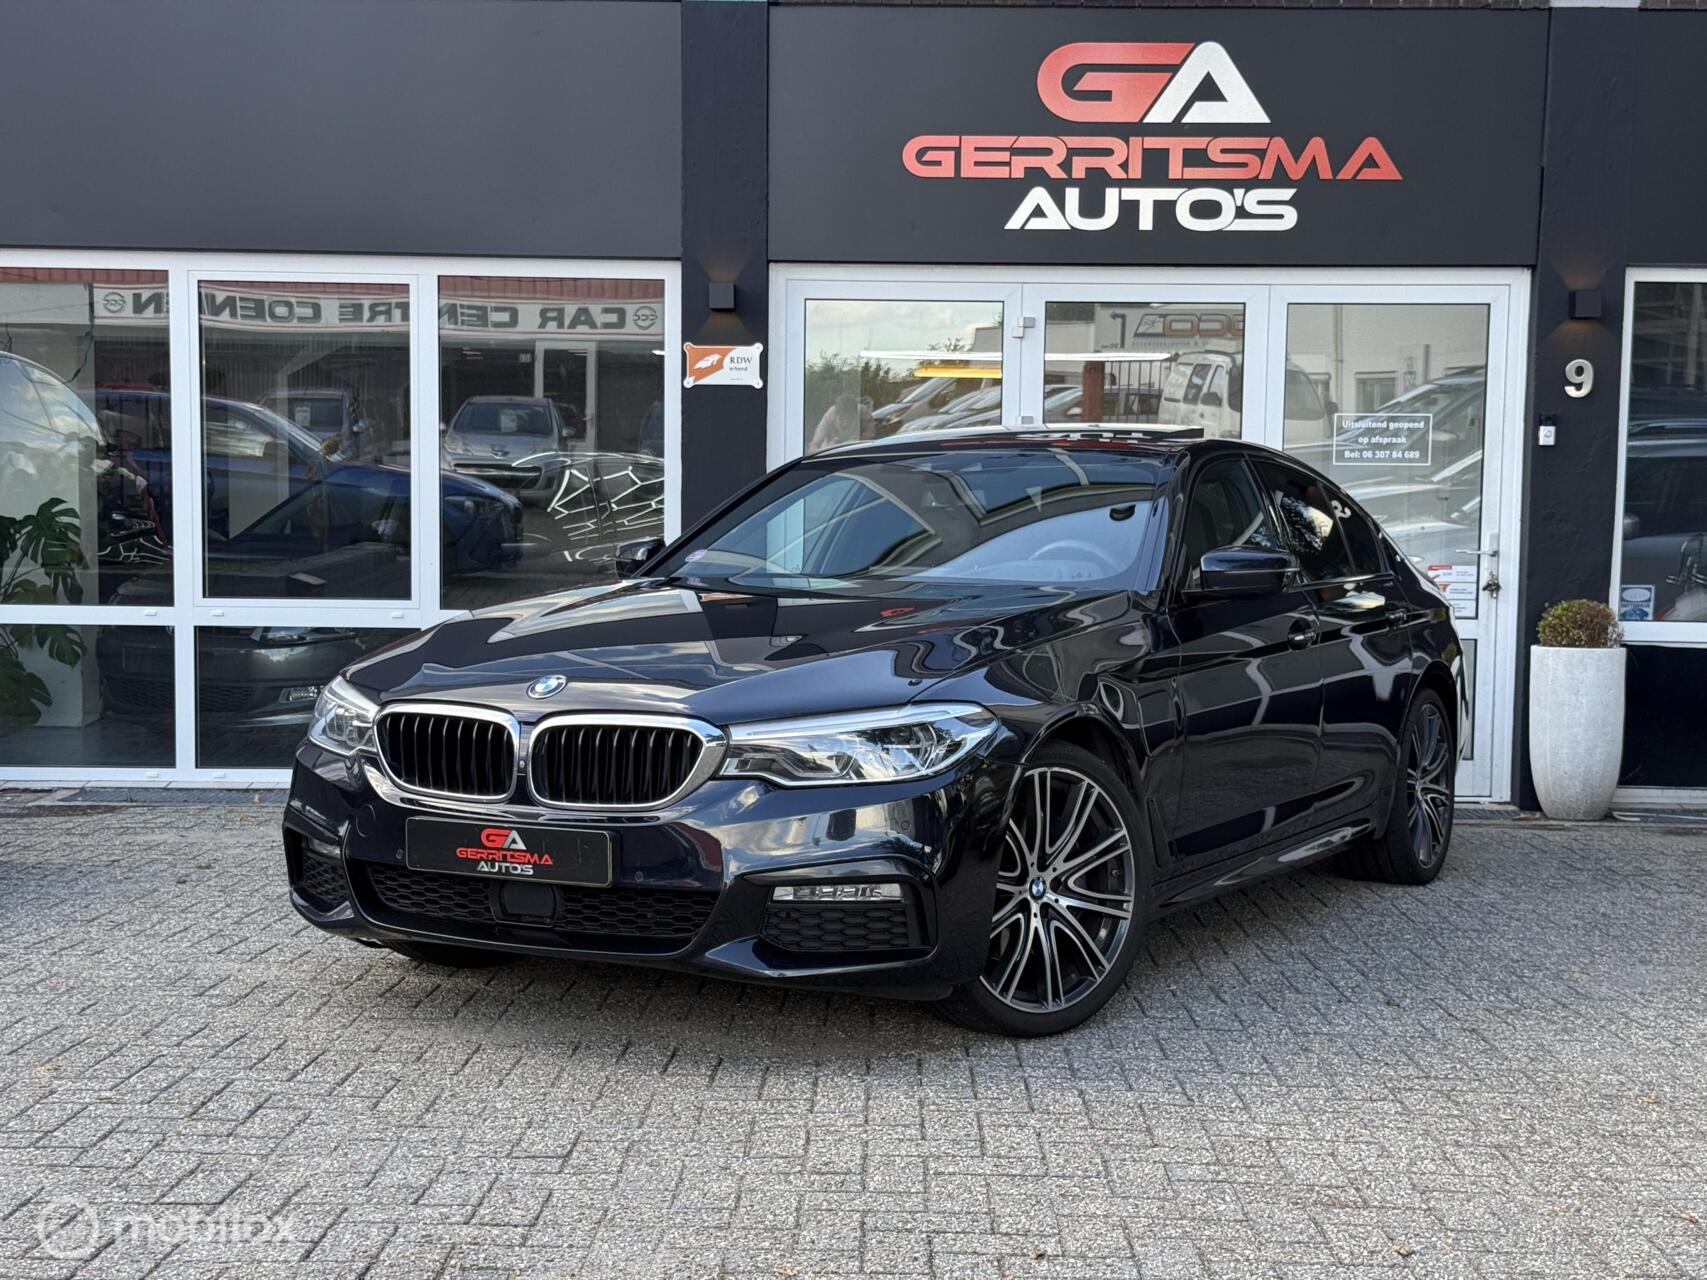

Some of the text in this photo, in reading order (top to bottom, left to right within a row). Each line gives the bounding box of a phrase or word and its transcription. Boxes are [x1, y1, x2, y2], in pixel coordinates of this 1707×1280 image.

[1037, 40, 1271, 124] GA
[901, 135, 1404, 180] GERRITSMA
[1003, 185, 1299, 232] AUTO'S
[729, 356, 753, 364] RDW
[1564, 358, 1594, 398] 9
[1342, 420, 1425, 430] Uitsluitend geopend
[1358, 436, 1407, 445] op afspraak
[1344, 450, 1420, 459] Bel: 06 307 84 689
[481, 828, 527, 850] GA
[456, 847, 554, 865] GERRITSMA
[476, 861, 534, 875] AUTO'S
